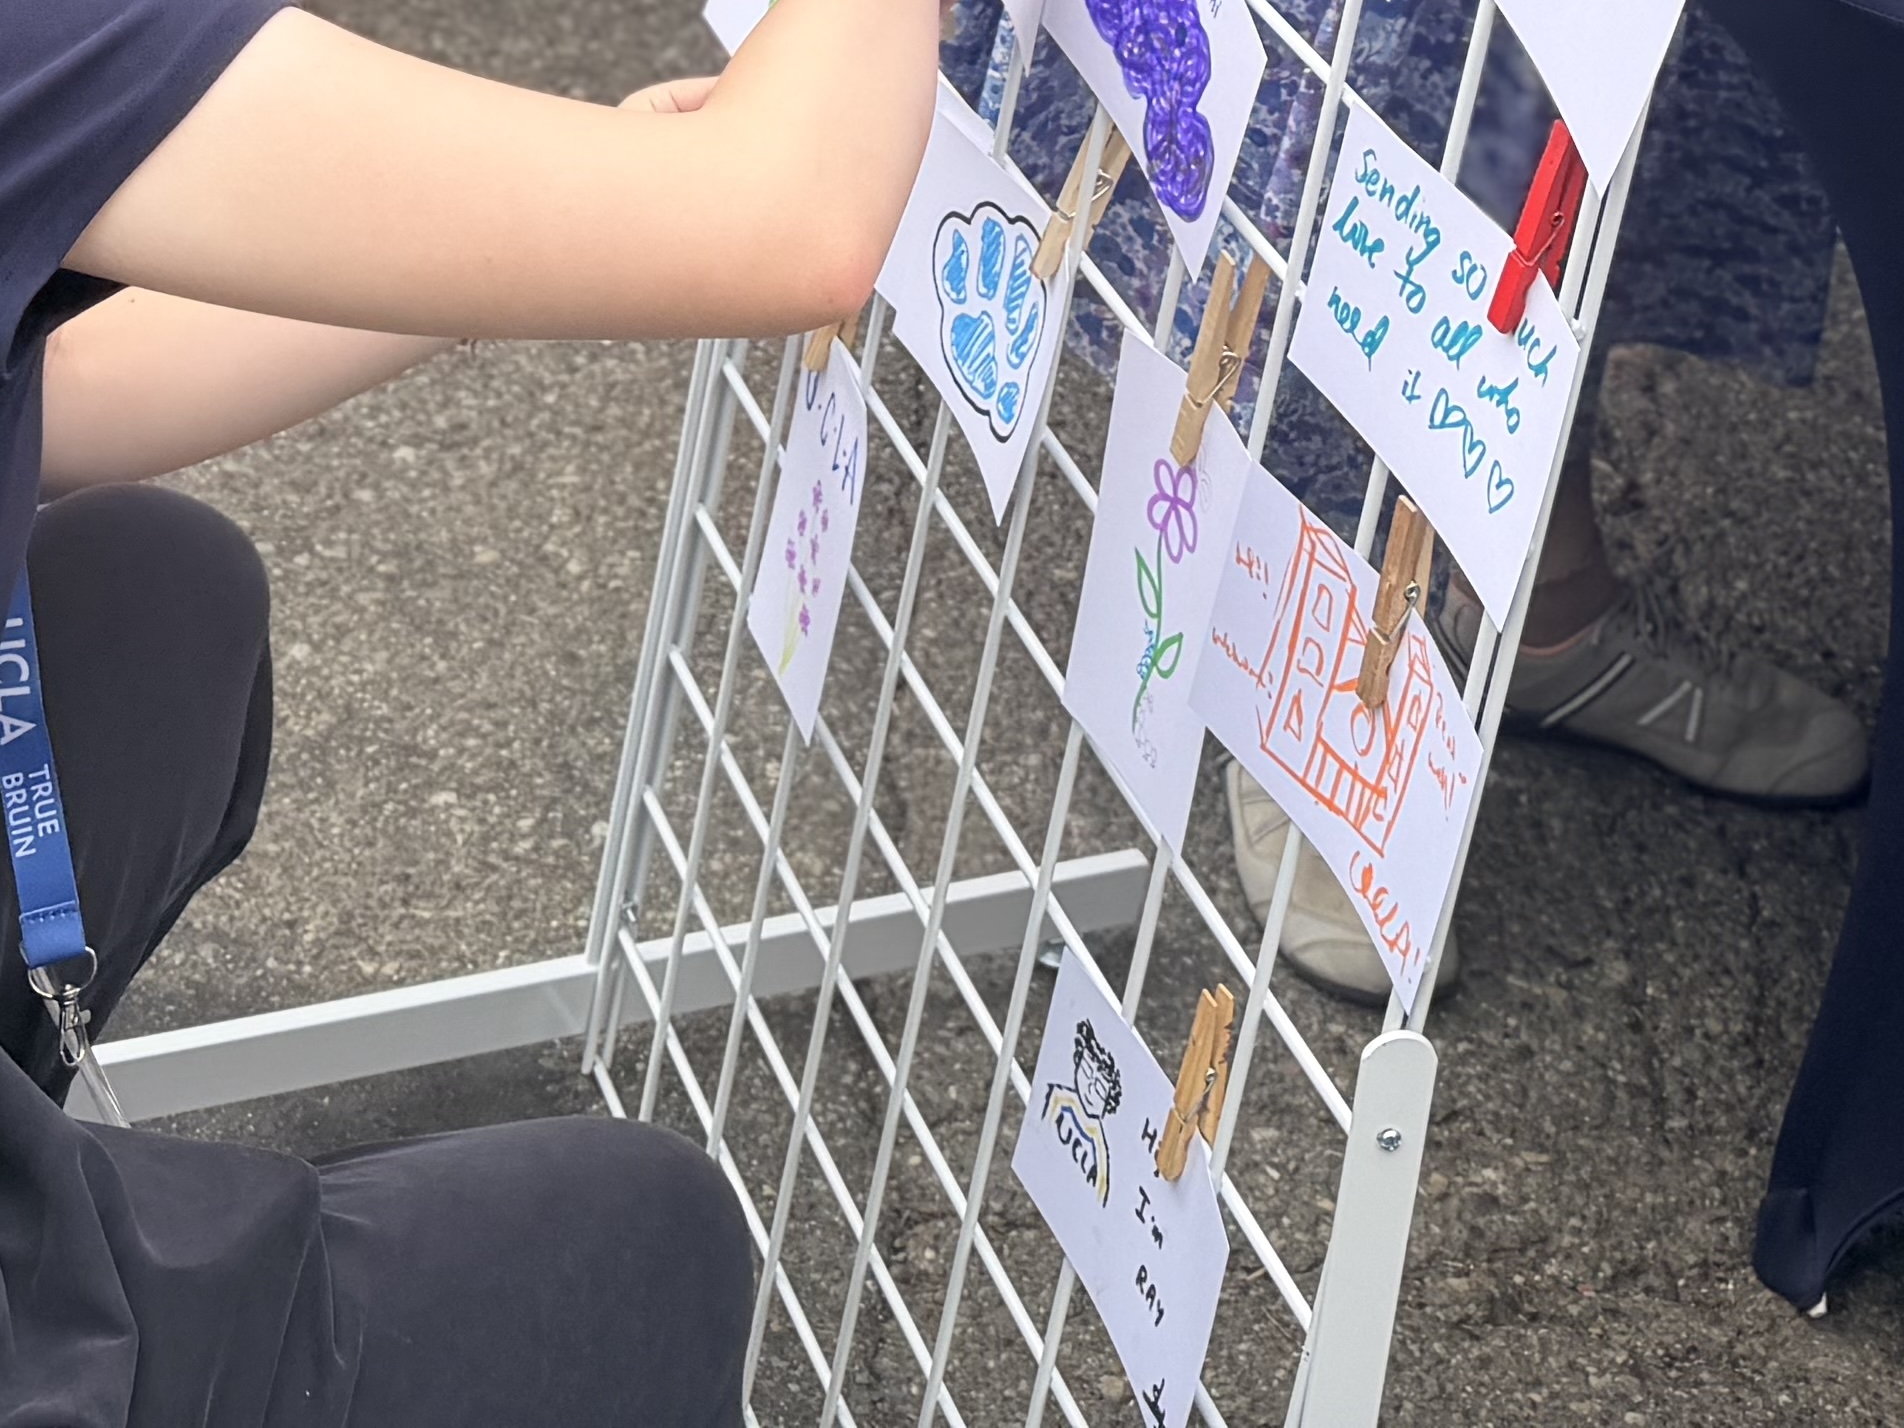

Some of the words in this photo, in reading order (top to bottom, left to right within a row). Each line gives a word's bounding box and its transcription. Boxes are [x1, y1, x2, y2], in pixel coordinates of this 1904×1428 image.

[1355, 148, 1441, 265] Sending
[1515, 317, 1558, 388] uch
[1327, 286, 1390, 372] need
[1401, 369, 1422, 405] it
[1333, 197, 1385, 269] love
[1394, 256, 1427, 314] to
[1431, 316, 1483, 370] all
[1477, 376, 1521, 434] who
[2, 773, 36, 858] BRUIN
[28, 765, 60, 837] TRUE
[1055, 1112, 1097, 1187] UCLA
[1135, 1185, 1164, 1250] I'm
